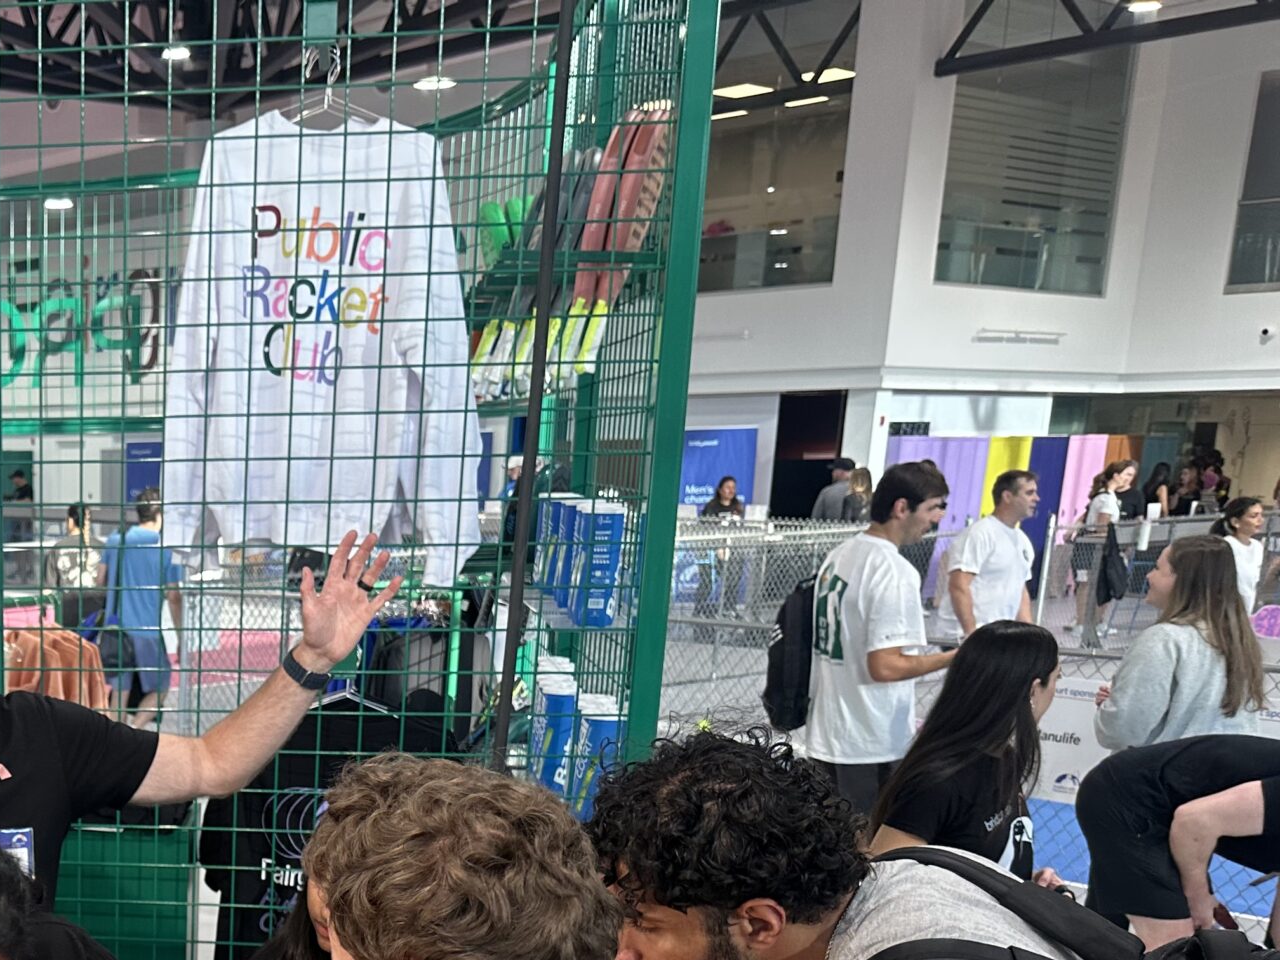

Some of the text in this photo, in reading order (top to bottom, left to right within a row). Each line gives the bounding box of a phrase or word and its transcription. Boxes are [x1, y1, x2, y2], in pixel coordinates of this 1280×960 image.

[252, 205, 391, 271] Public
[243, 265, 390, 335] Racket
[263, 322, 343, 386] Club
[1039, 729, 1081, 746] anulife
